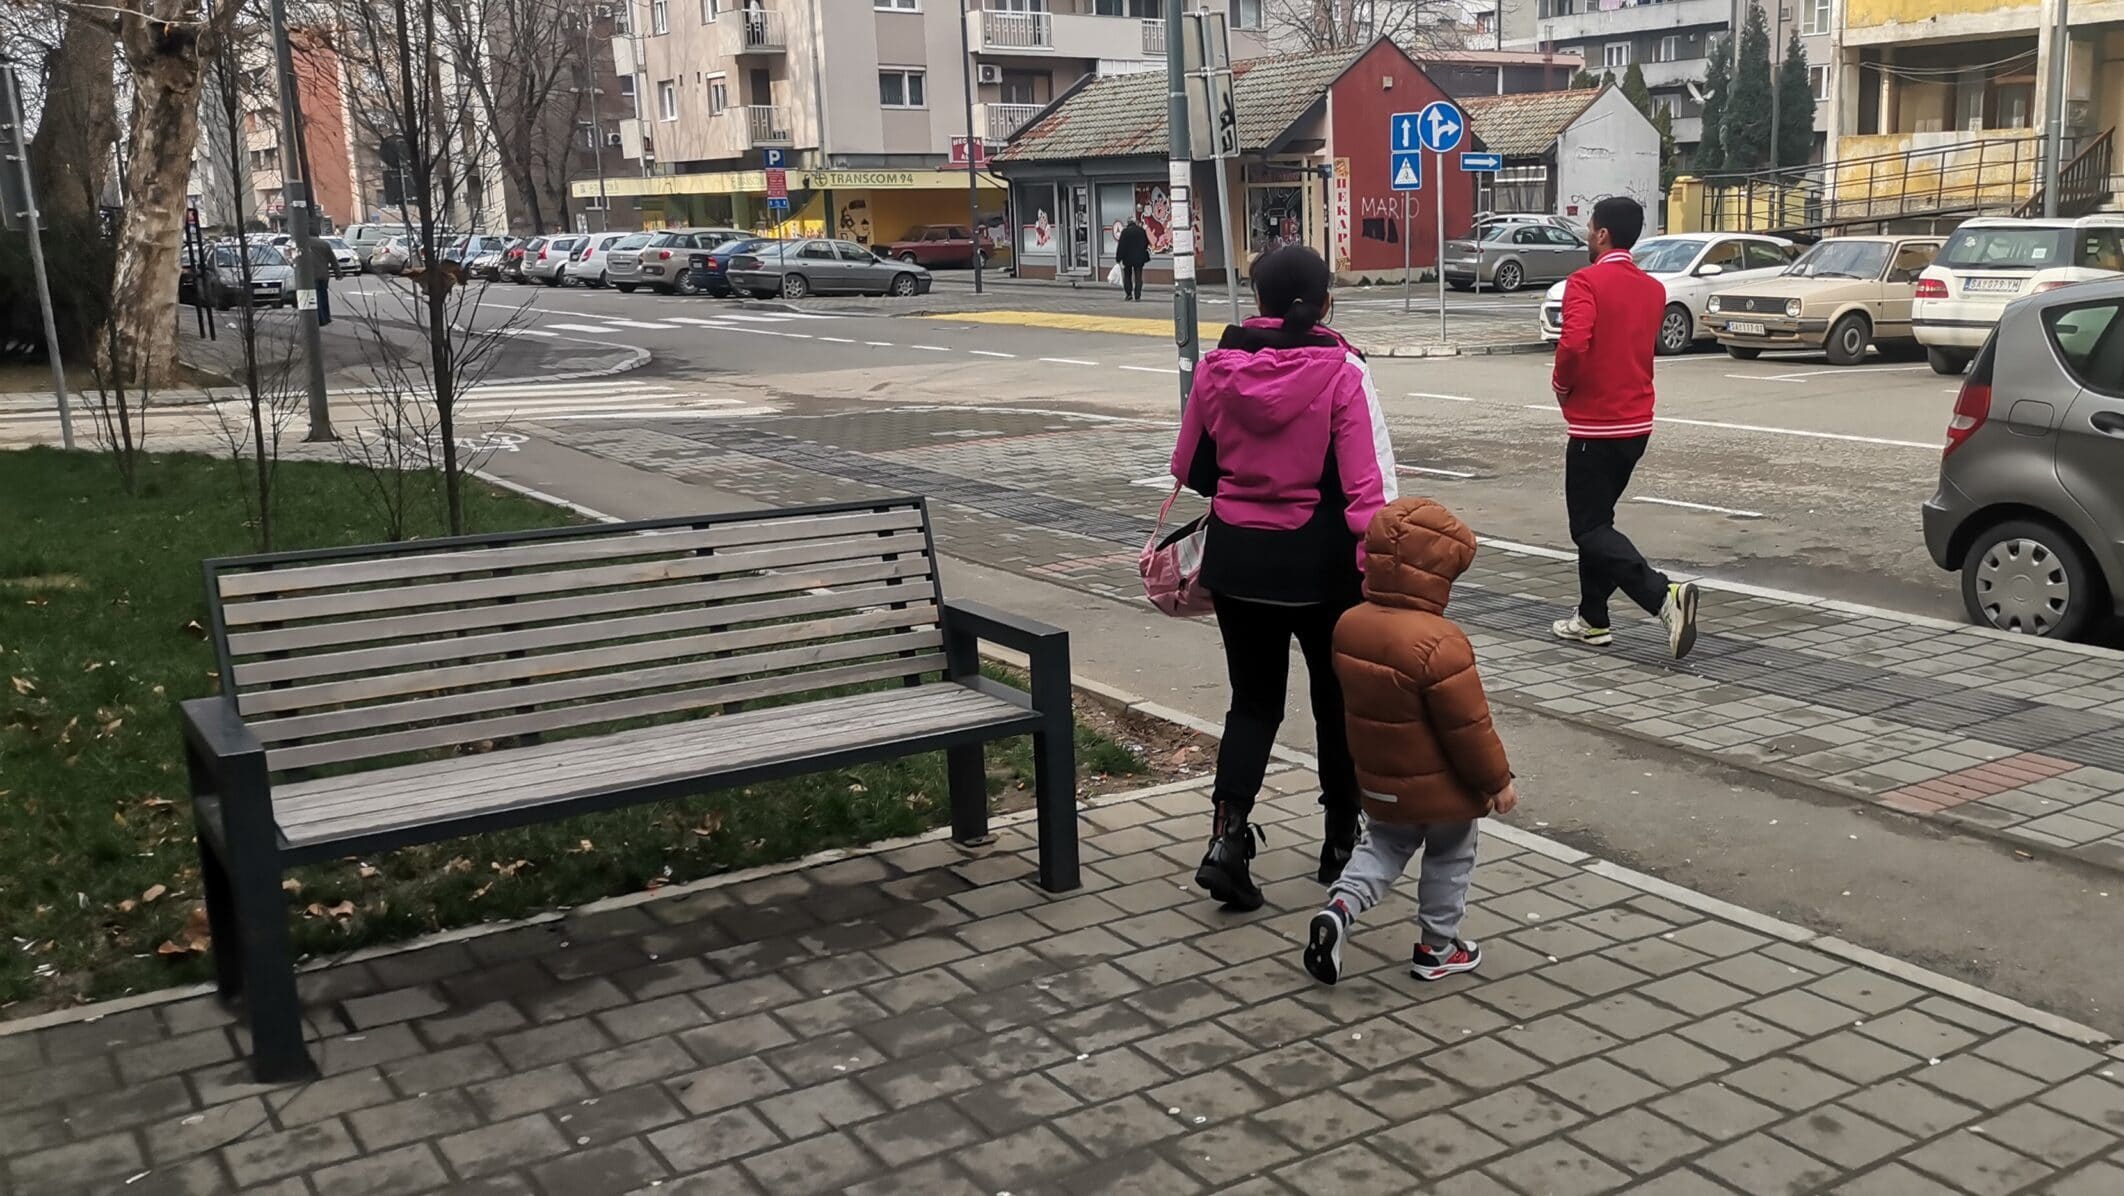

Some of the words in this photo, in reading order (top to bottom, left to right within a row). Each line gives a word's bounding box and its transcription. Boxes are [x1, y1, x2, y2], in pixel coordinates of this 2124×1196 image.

[769, 150, 780, 165] P
[830, 173, 897, 184] TRANSCOM
[899, 173, 913, 184] 94
